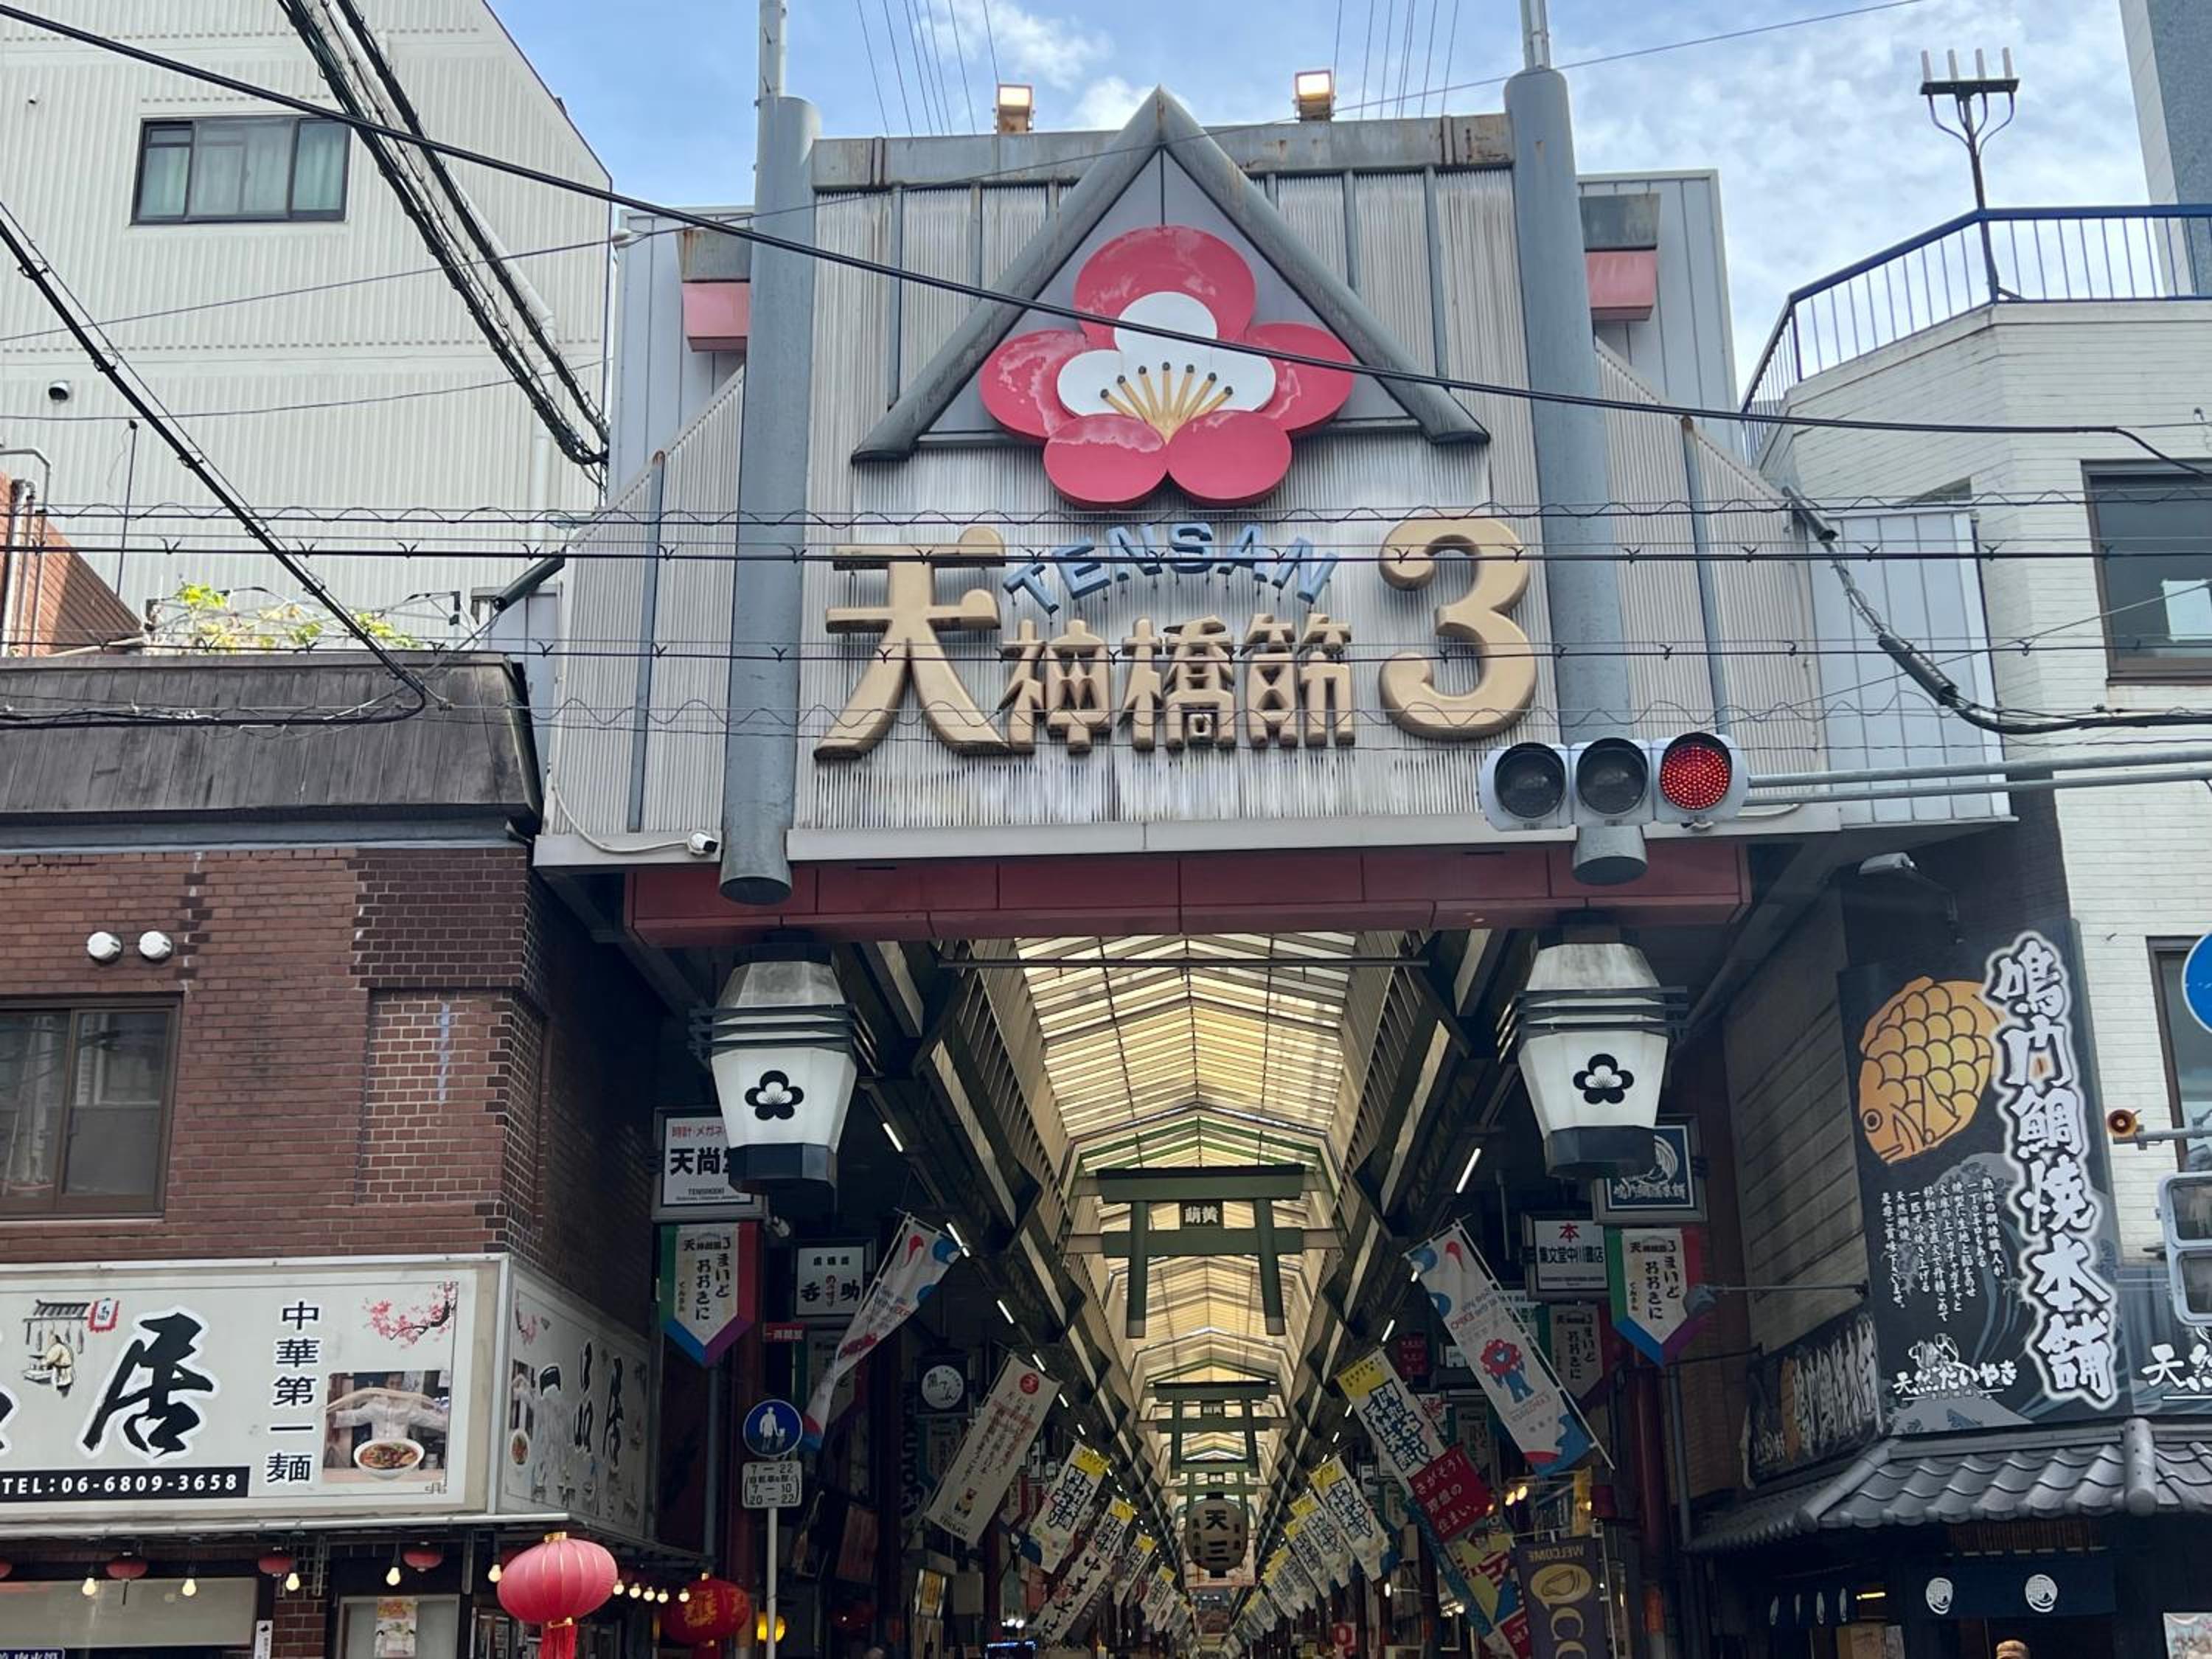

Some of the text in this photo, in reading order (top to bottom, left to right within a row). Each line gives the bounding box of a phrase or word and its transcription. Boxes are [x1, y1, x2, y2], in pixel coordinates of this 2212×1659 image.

[1002, 521, 1338, 615] TENSAN
[1992, 939, 2113, 1399] 鳴門鯛焼本舗
[1559, 1223, 1580, 1243] 本
[695, 1259, 712, 1321] おおきに
[715, 1253, 731, 1298] まいど
[1645, 1262, 1663, 1320] おおきに
[1664, 1256, 1680, 1298] まいど
[266, 1301, 320, 1484] 中華第一麺
[1892, 1359, 2018, 1396] 天然たいやき
